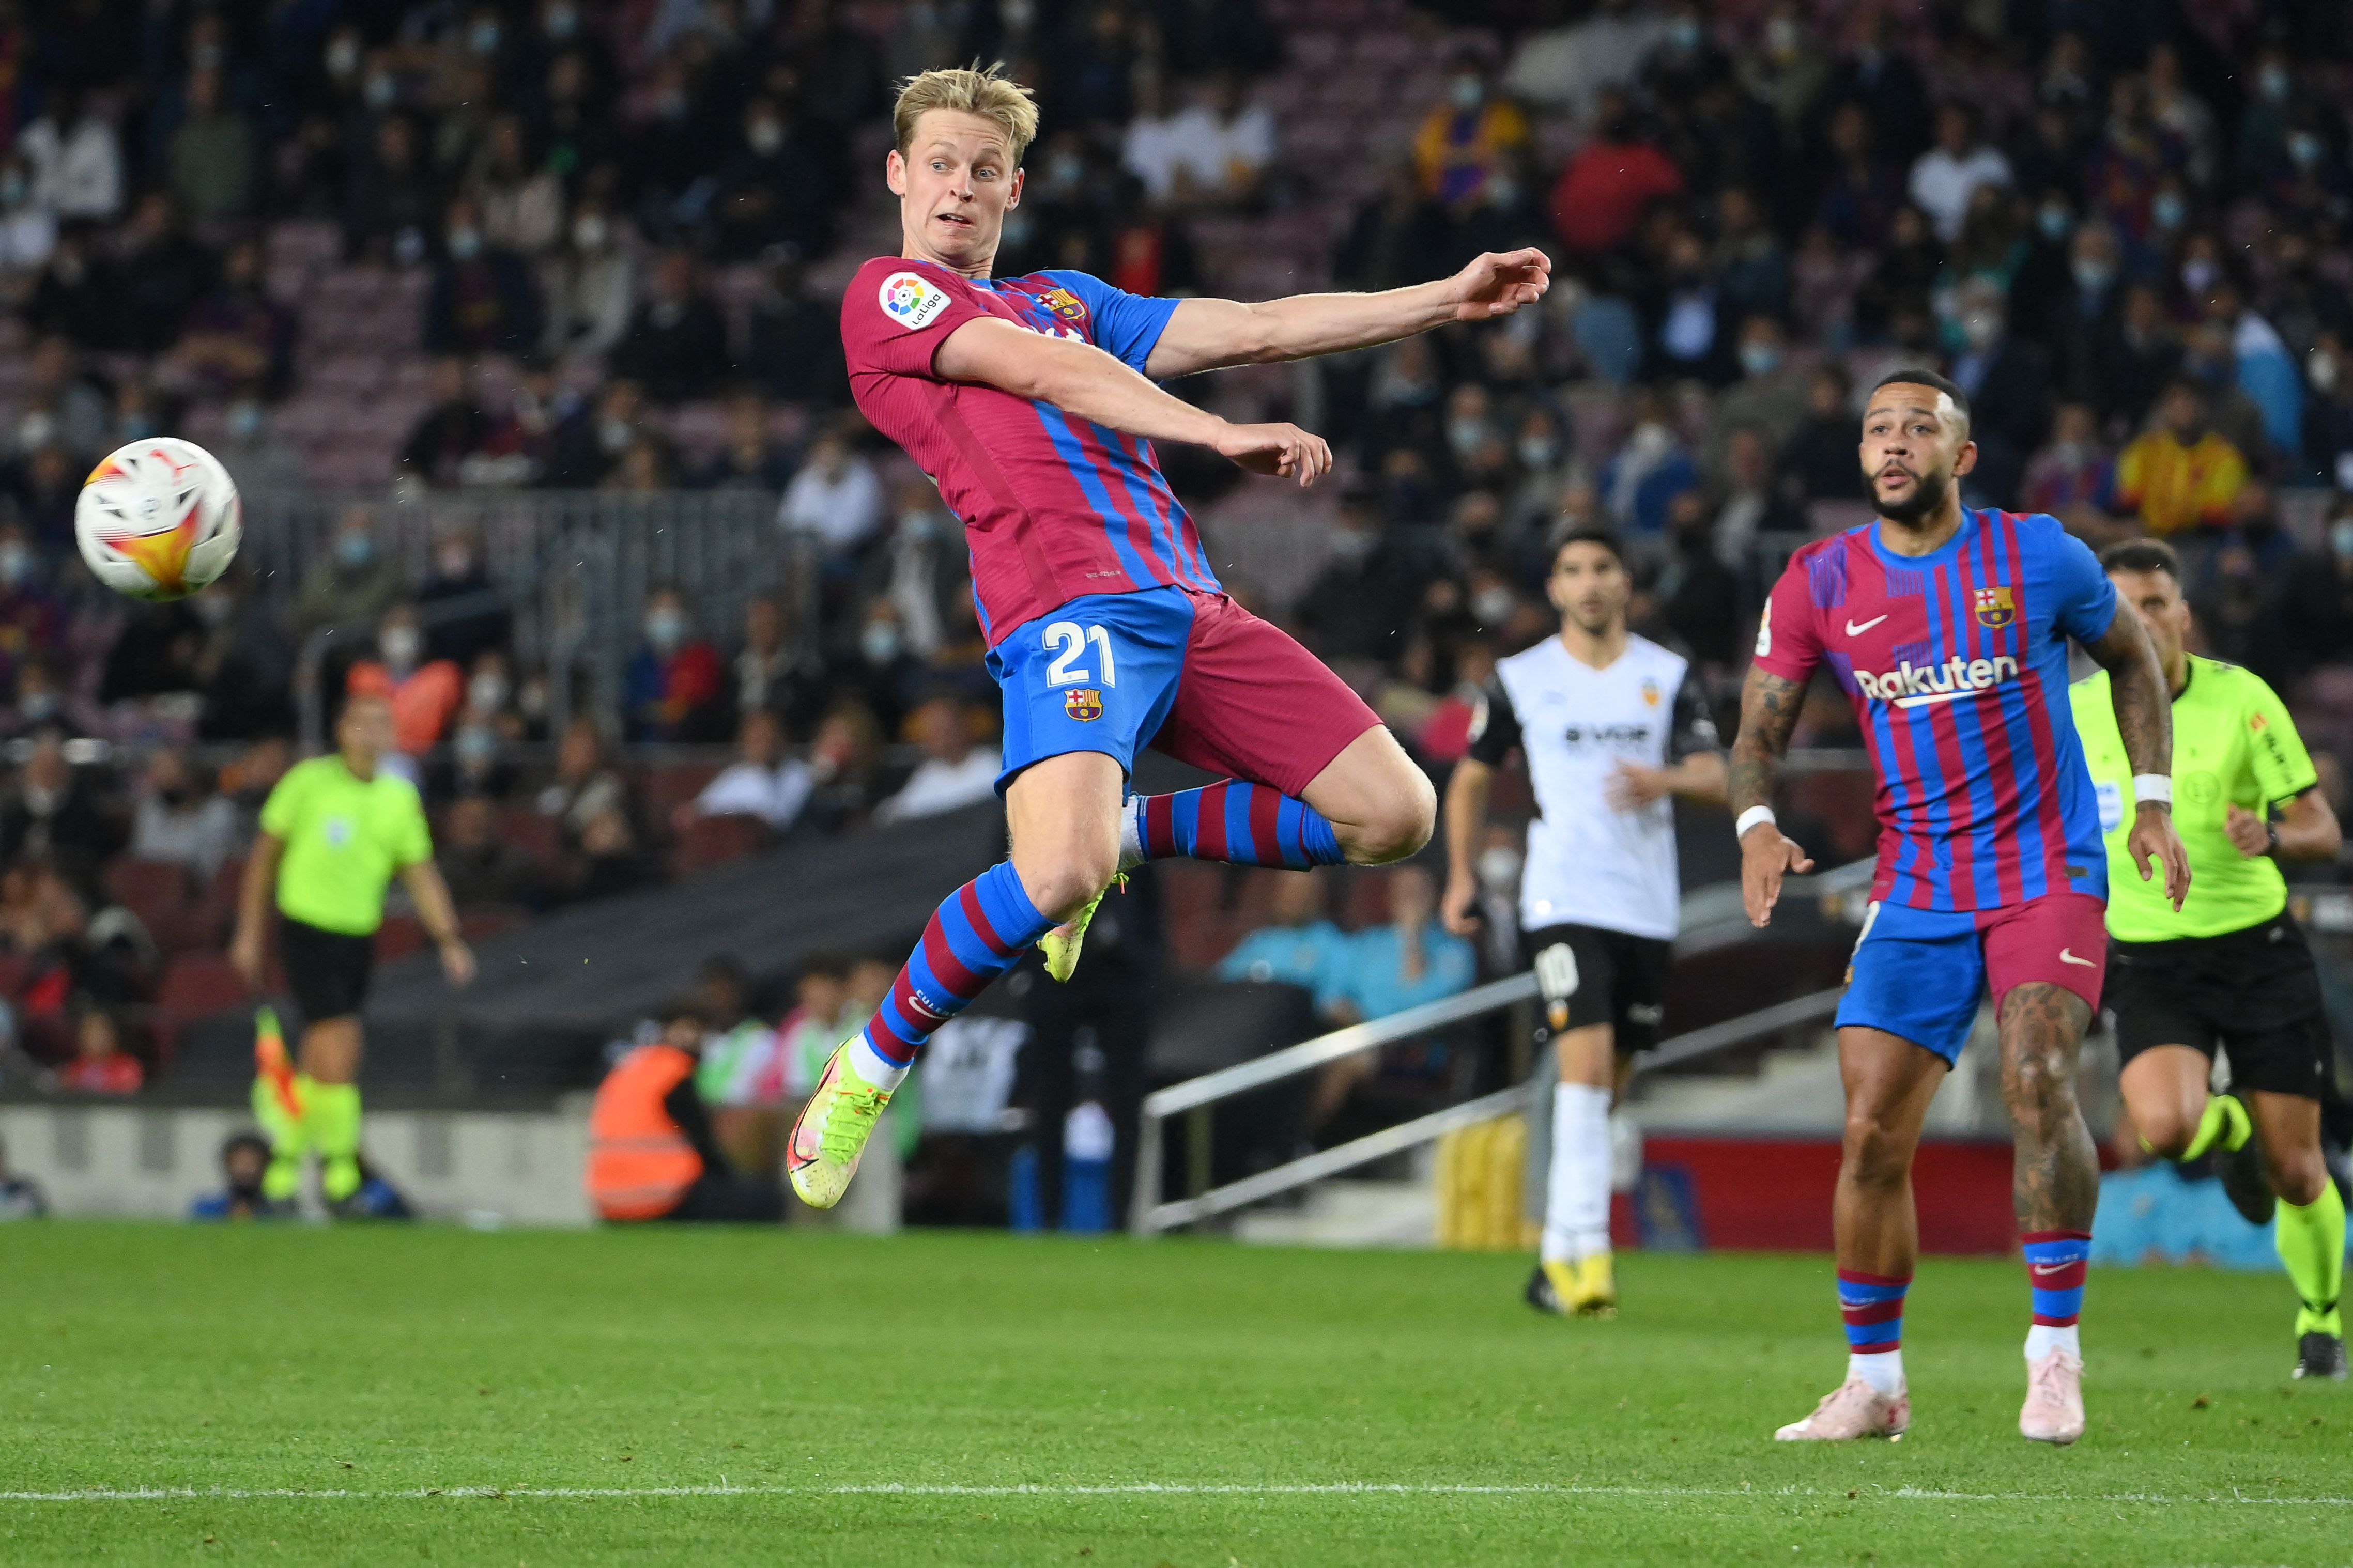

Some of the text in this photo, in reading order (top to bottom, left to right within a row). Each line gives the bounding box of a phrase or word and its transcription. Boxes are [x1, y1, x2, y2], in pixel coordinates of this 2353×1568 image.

[912, 294, 942, 325] LaLiga
[1042, 621, 1116, 689] 21
[1853, 655, 2019, 700] Rakuten
